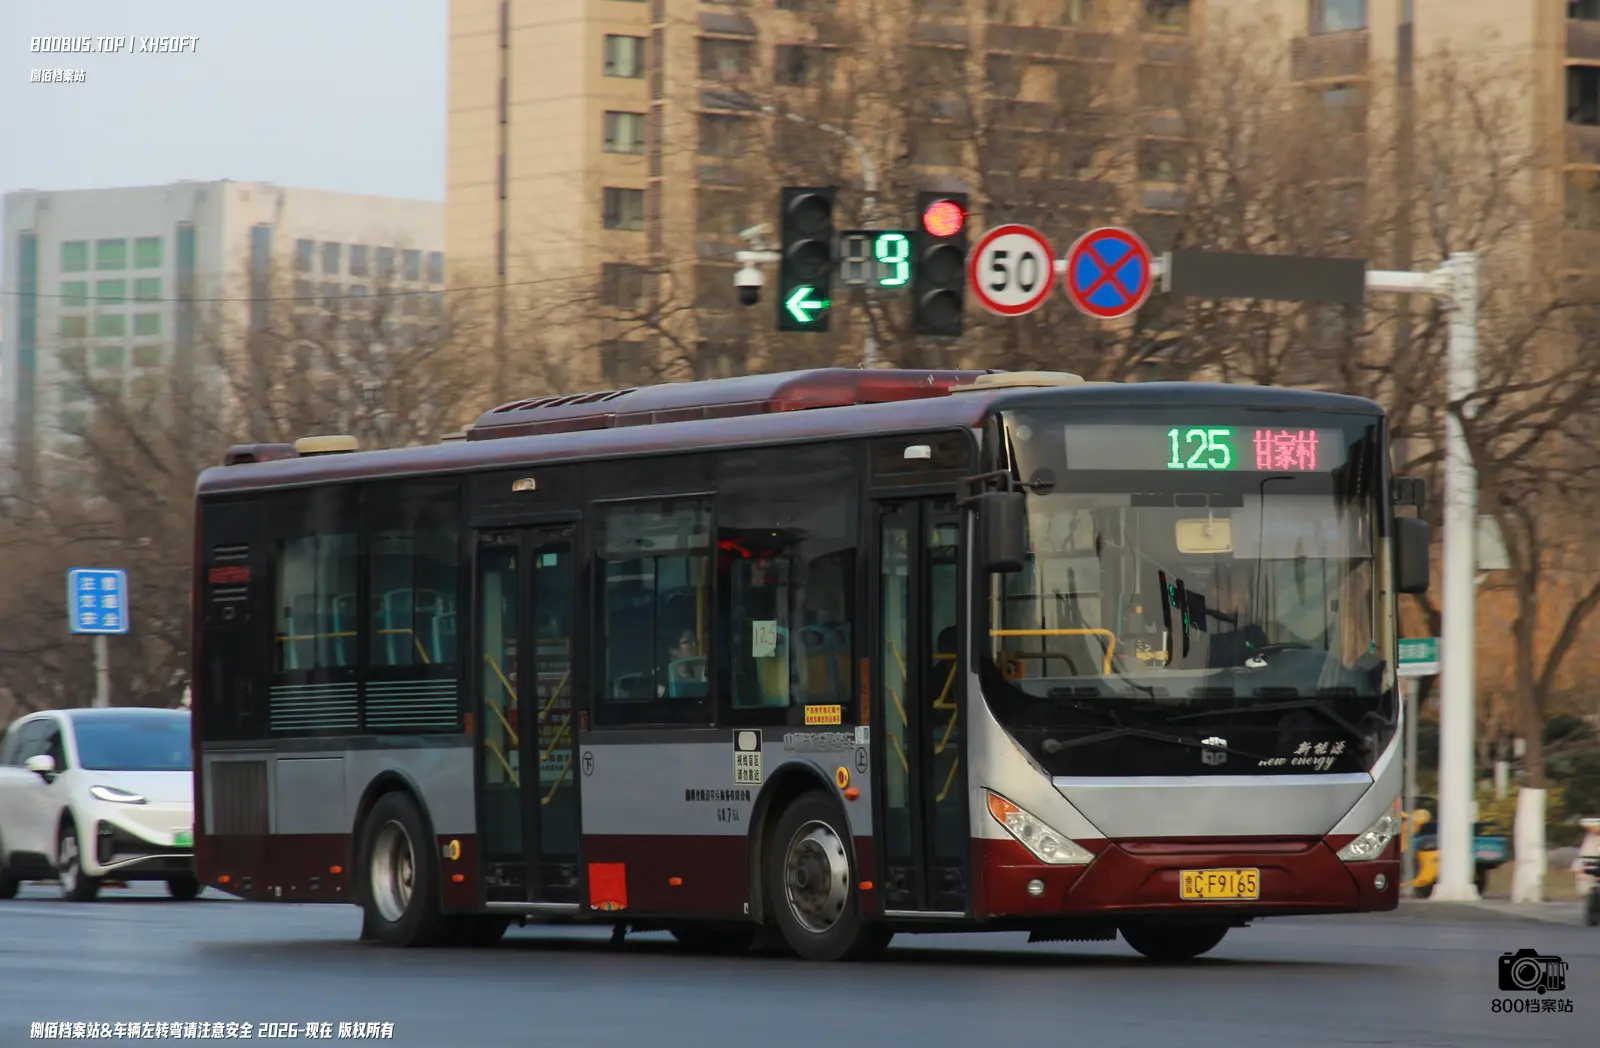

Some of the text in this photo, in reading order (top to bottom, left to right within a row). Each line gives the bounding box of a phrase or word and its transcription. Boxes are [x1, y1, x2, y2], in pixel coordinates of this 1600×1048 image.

[875, 233, 909, 286] 9
[991, 250, 1038, 293] 50
[1167, 428, 1231, 469] 125
[1253, 429, 1318, 470] 甘家村
[755, 623, 777, 647] 125
[1258, 756, 1334, 771] new energy
[1293, 741, 1346, 756] 新能源
